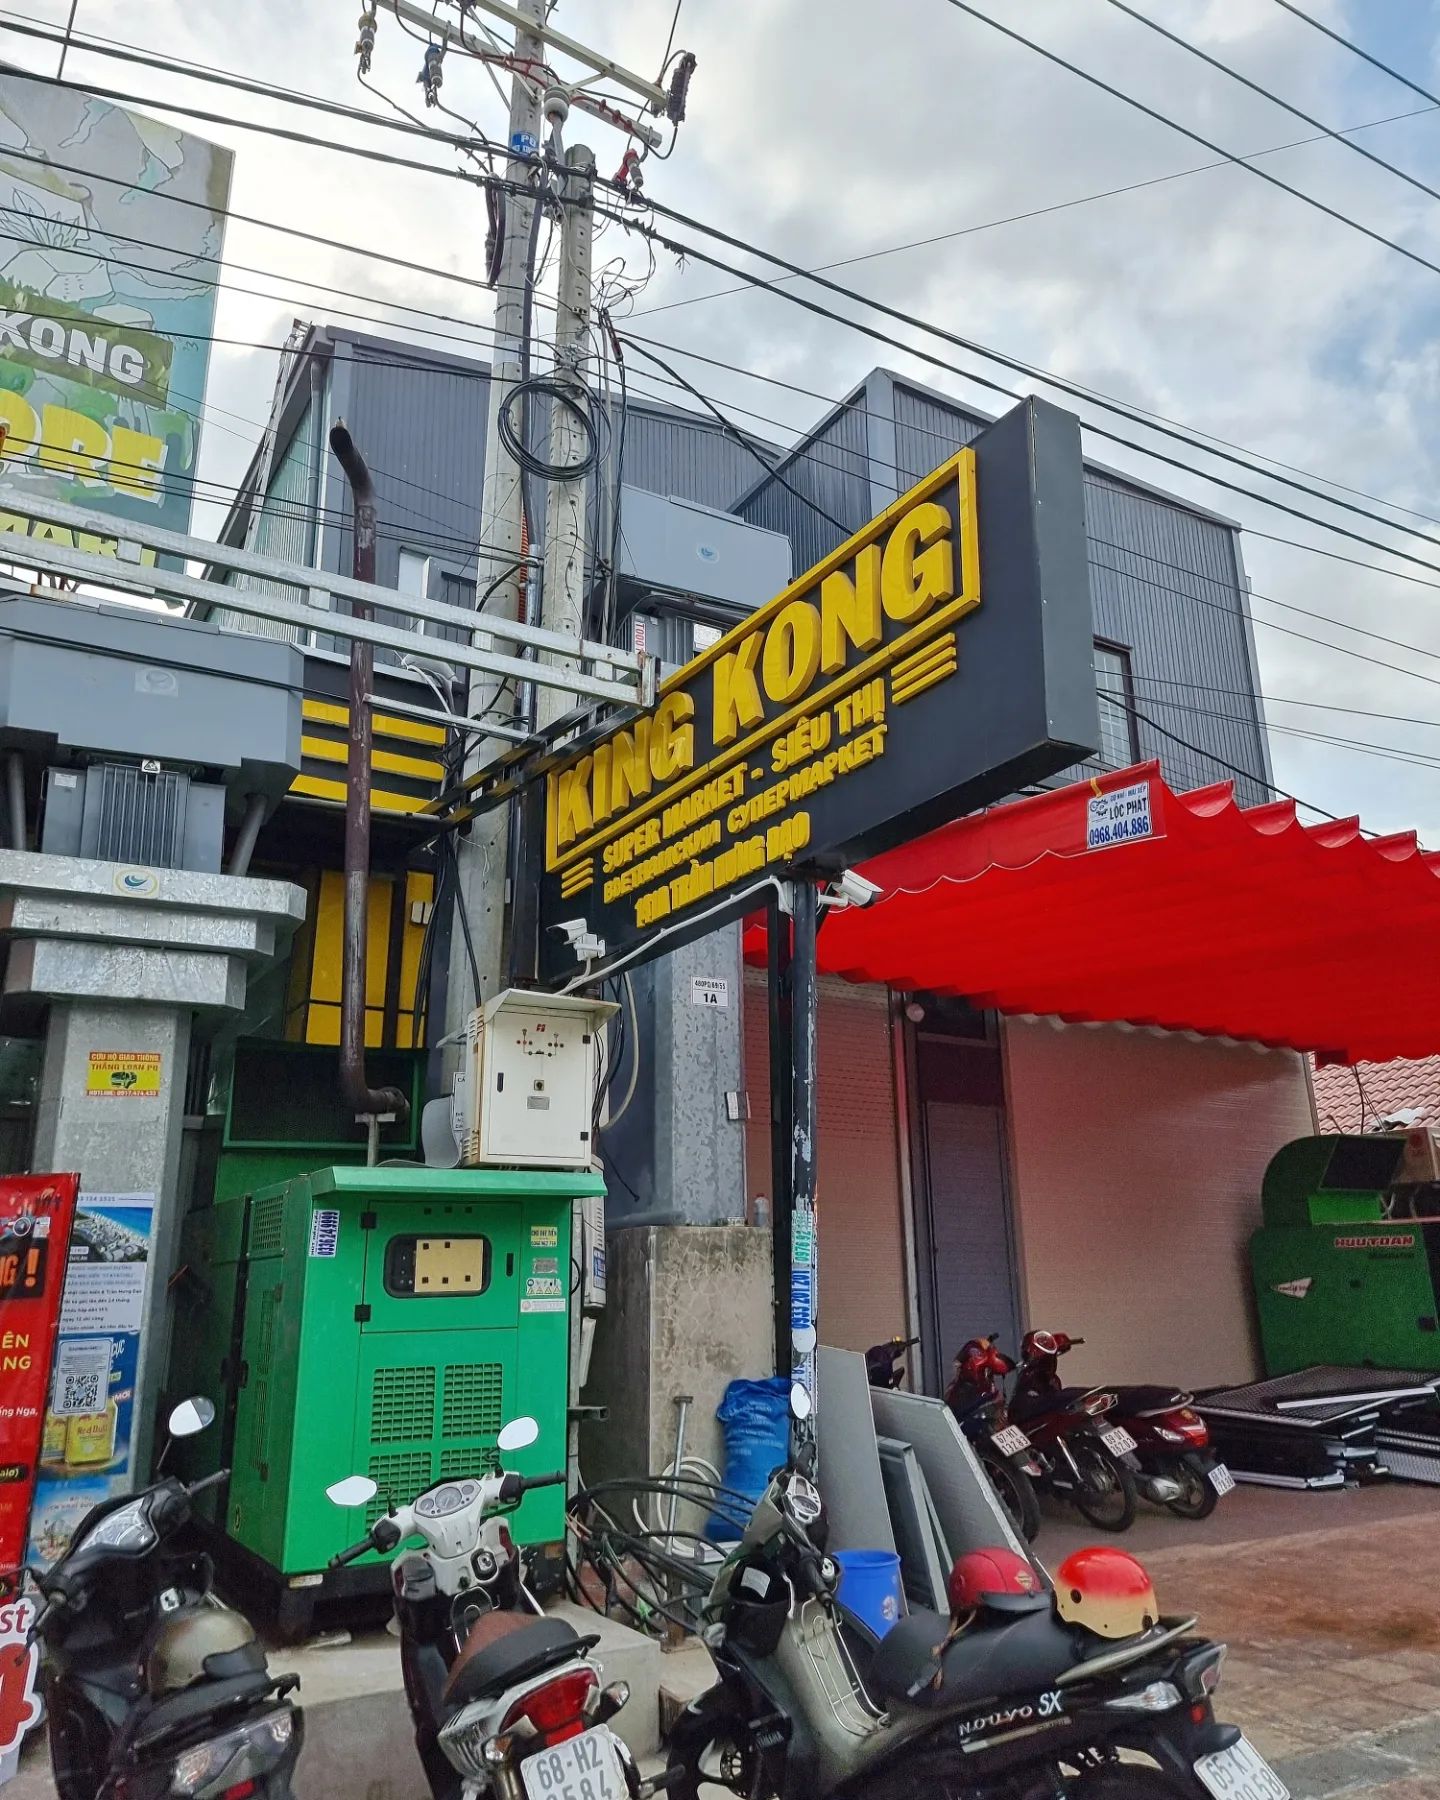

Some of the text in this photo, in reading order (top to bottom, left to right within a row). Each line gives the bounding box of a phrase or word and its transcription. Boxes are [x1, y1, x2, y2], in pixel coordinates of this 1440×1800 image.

[556, 502, 953, 847] KING KONG
[602, 817, 662, 874] SUPER
[662, 761, 748, 840] MARKET
[770, 713, 832, 774] SIÊU
[833, 677, 888, 738] THỊ
[1109, 795, 1147, 821] LỘC PHÁT
[1089, 815, 1150, 846] 0968.404.886
[1038, 1690, 1064, 1716] SX
[536, 1735, 604, 1790] 68-H2
